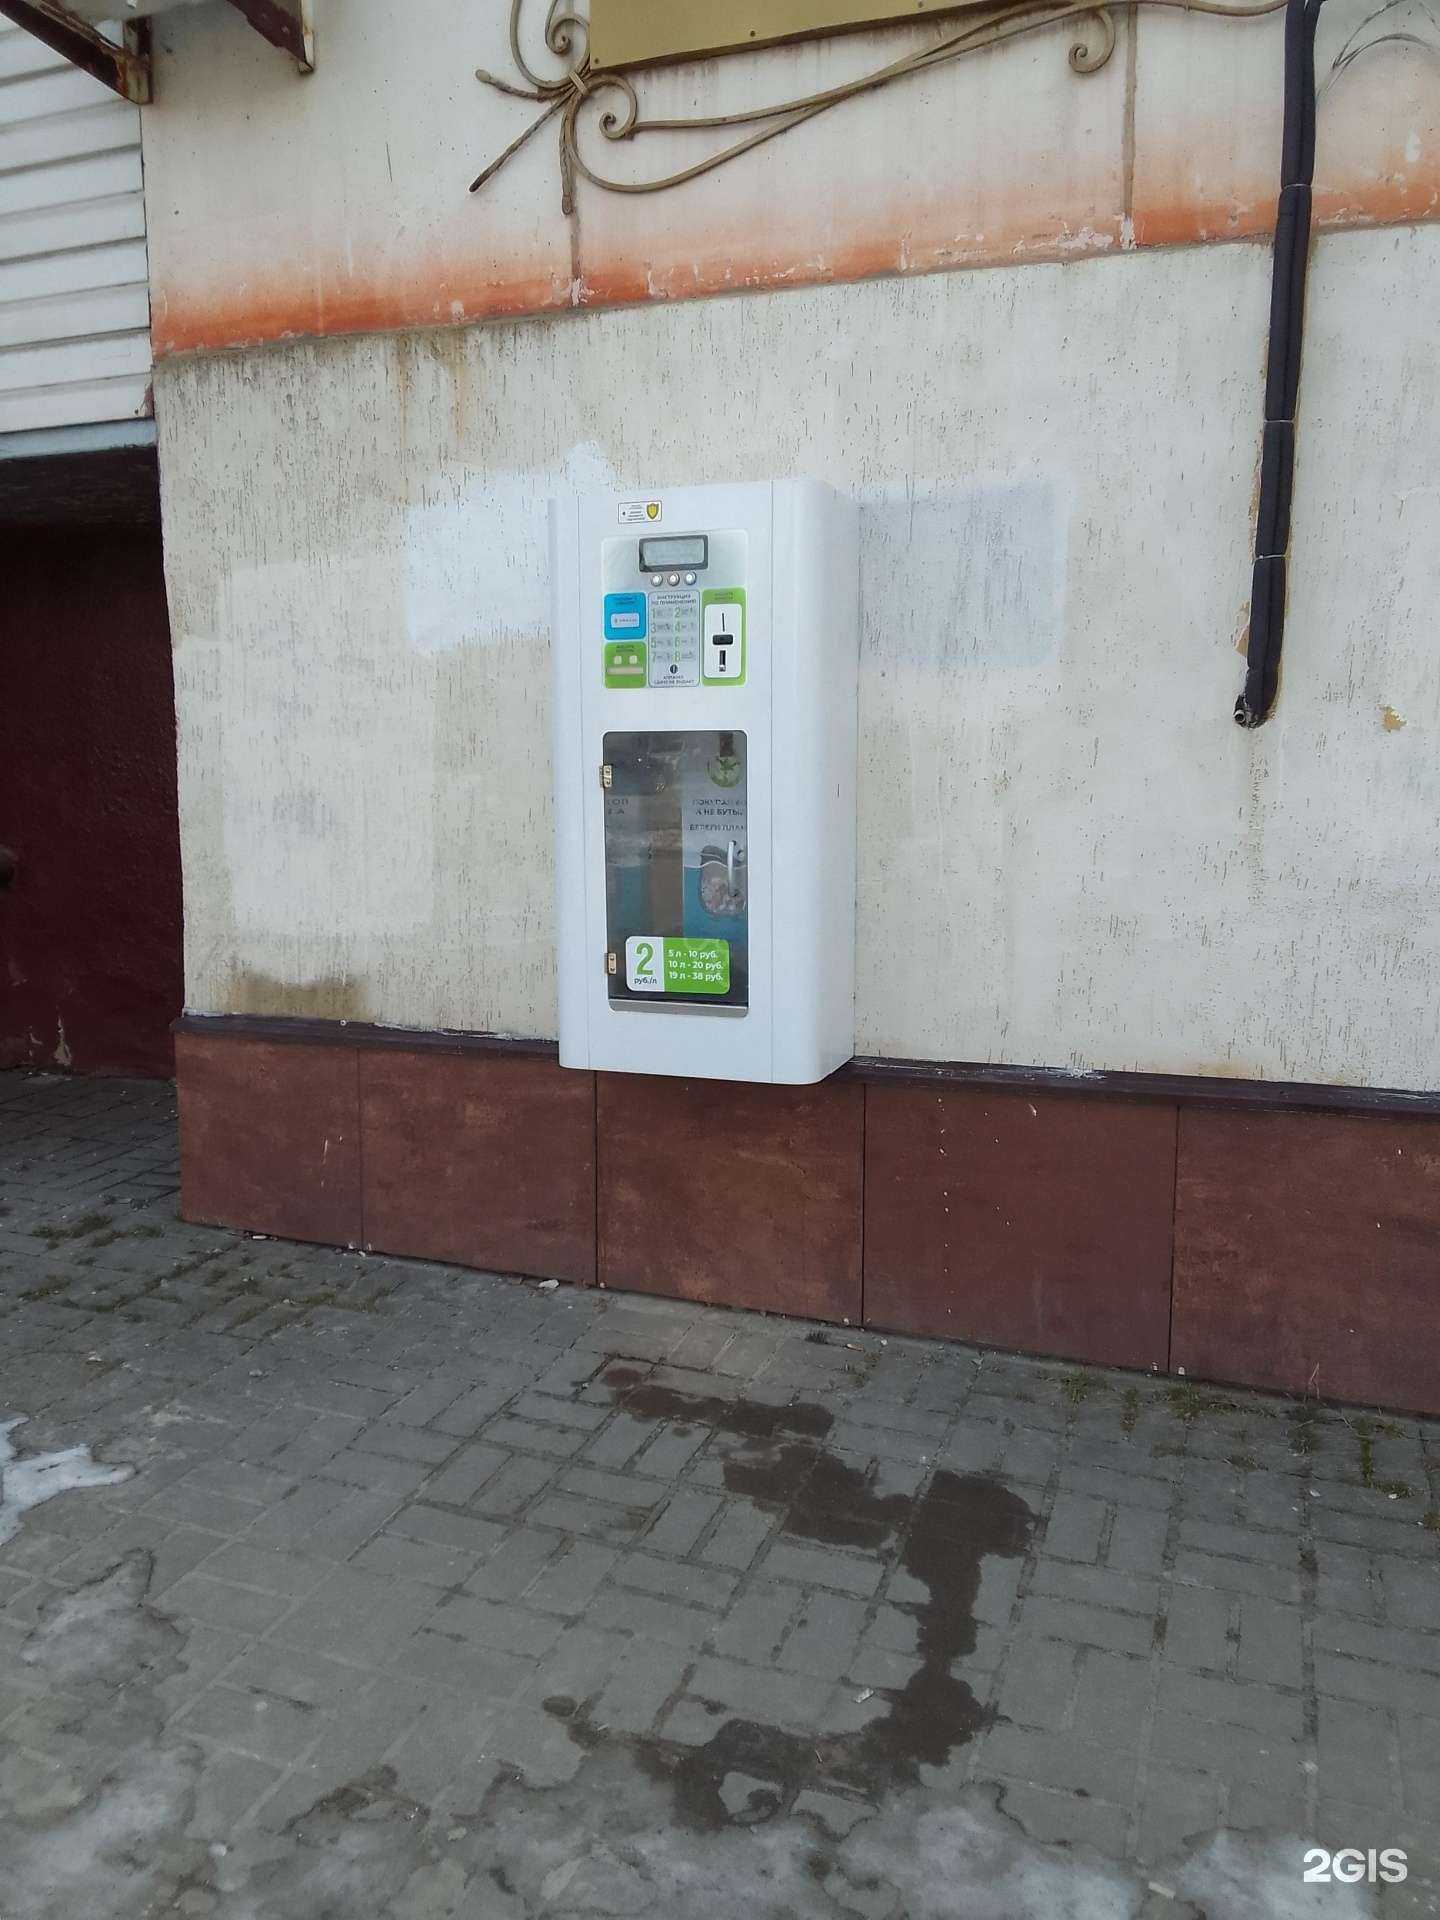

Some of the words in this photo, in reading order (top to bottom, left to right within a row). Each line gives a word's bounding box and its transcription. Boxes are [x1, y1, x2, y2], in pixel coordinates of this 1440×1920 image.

[636, 942, 654, 975] 2
[699, 950, 718, 959] руб.
[669, 960, 678, 968] 10
[705, 961, 723, 971] руб.
[669, 971, 677, 979] 19
[693, 972, 703, 980] 38
[705, 972, 723, 982] руб.
